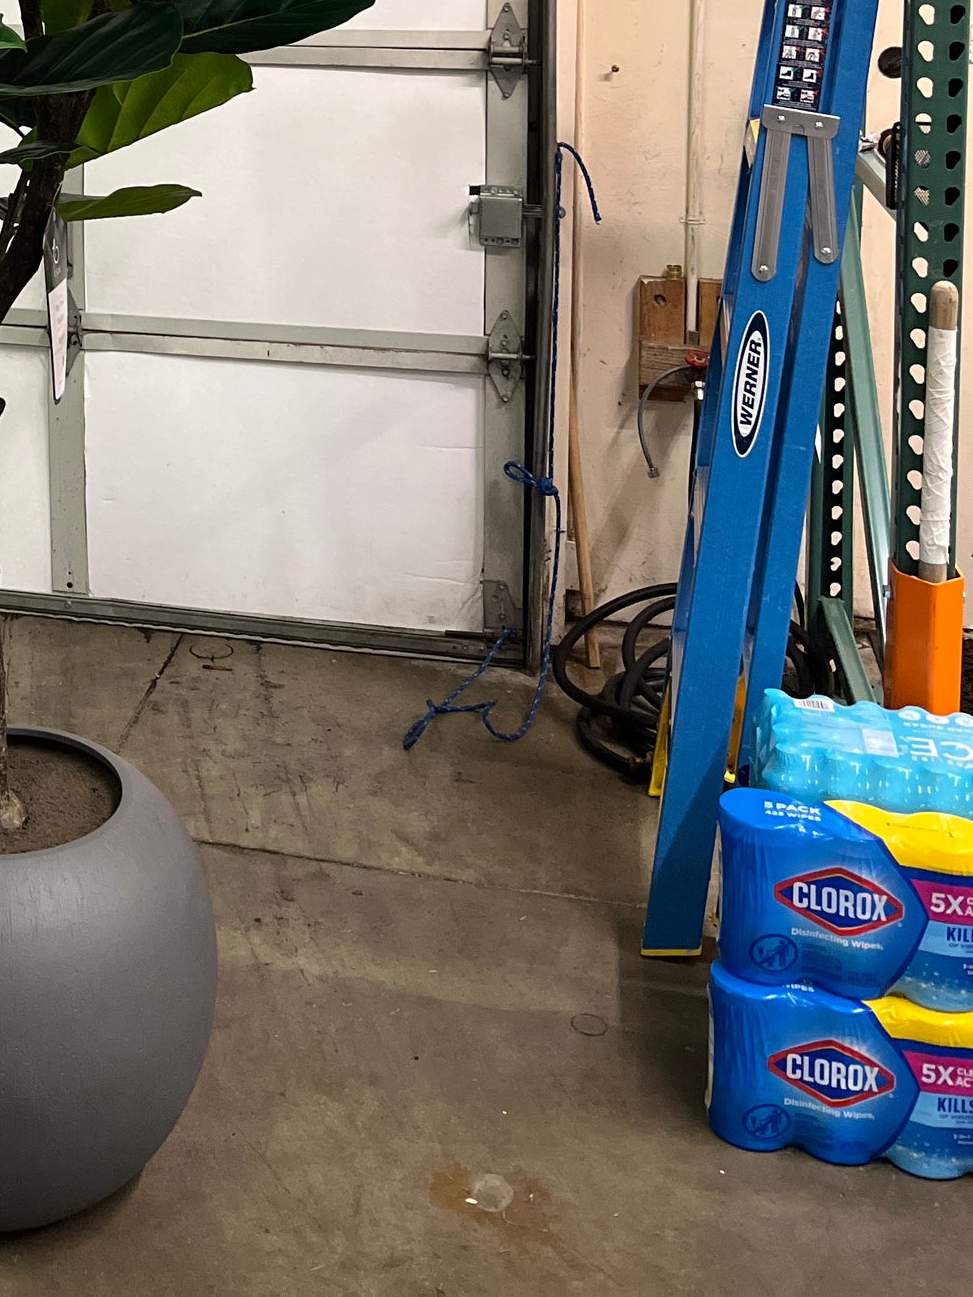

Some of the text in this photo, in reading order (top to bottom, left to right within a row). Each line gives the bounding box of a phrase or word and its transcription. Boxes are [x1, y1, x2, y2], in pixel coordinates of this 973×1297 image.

[739, 339, 762, 426] WERNER
[776, 803, 821, 816] PACK
[792, 881, 888, 922] CLOROX
[930, 892, 964, 915] 5X
[791, 927, 849, 947] Disinfecting
[786, 1053, 879, 1093] CLOROX
[921, 1063, 955, 1086] 5X
[783, 1097, 841, 1118] Disinfecting
